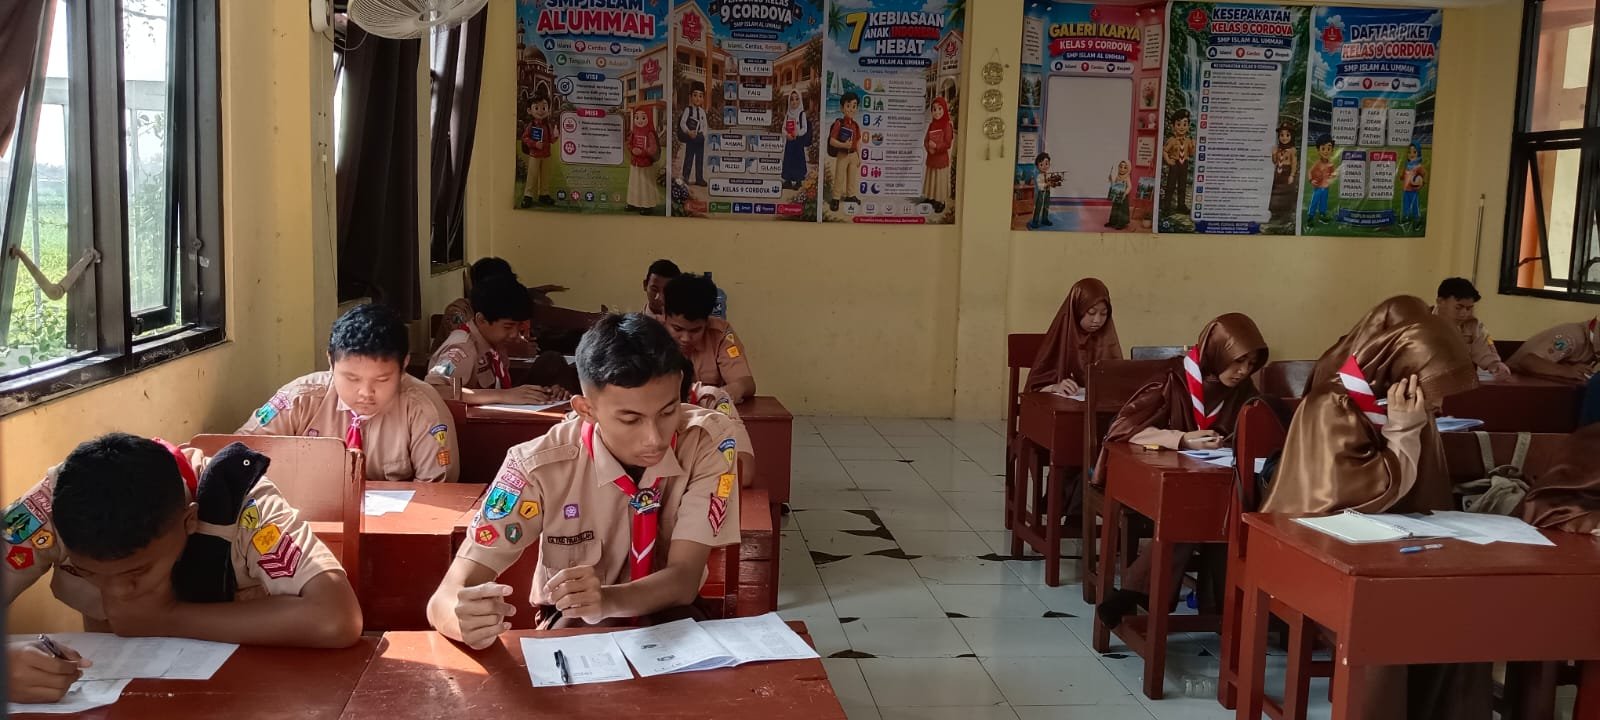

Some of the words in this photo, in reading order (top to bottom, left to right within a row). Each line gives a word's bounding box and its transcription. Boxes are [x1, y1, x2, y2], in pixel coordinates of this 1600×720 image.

[721, 5, 731, 22] 9
[732, 4, 792, 24] CORDOVA
[869, 12, 944, 28] KEBIASAAN
[1213, 9, 1291, 22] KESEPAKATAN
[537, 10, 566, 32] AL
[567, 10, 654, 36] UMMAH
[1212, 22, 1241, 34] KELAS
[1242, 24, 1249, 33] 9
[1250, 23, 1292, 35] CORDOVA
[847, 12, 867, 52] 7
[865, 28, 889, 39] ANAK
[1050, 23, 1097, 38] GALERI
[1099, 24, 1140, 40] KARYA
[1351, 25, 1398, 41] DAFTAR
[1399, 25, 1432, 40] PIKET
[876, 40, 925, 55] HEBAT
[1060, 40, 1086, 50] KELAS
[1088, 41, 1094, 50] 9
[1095, 41, 1133, 52] CORDOVA
[1342, 44, 1375, 59] KELAS
[1377, 45, 1384, 57] 9
[1385, 43, 1434, 57] CORDOVA
[1343, 65, 1357, 73] SMP
[1390, 65, 1414, 73] UMMAH
